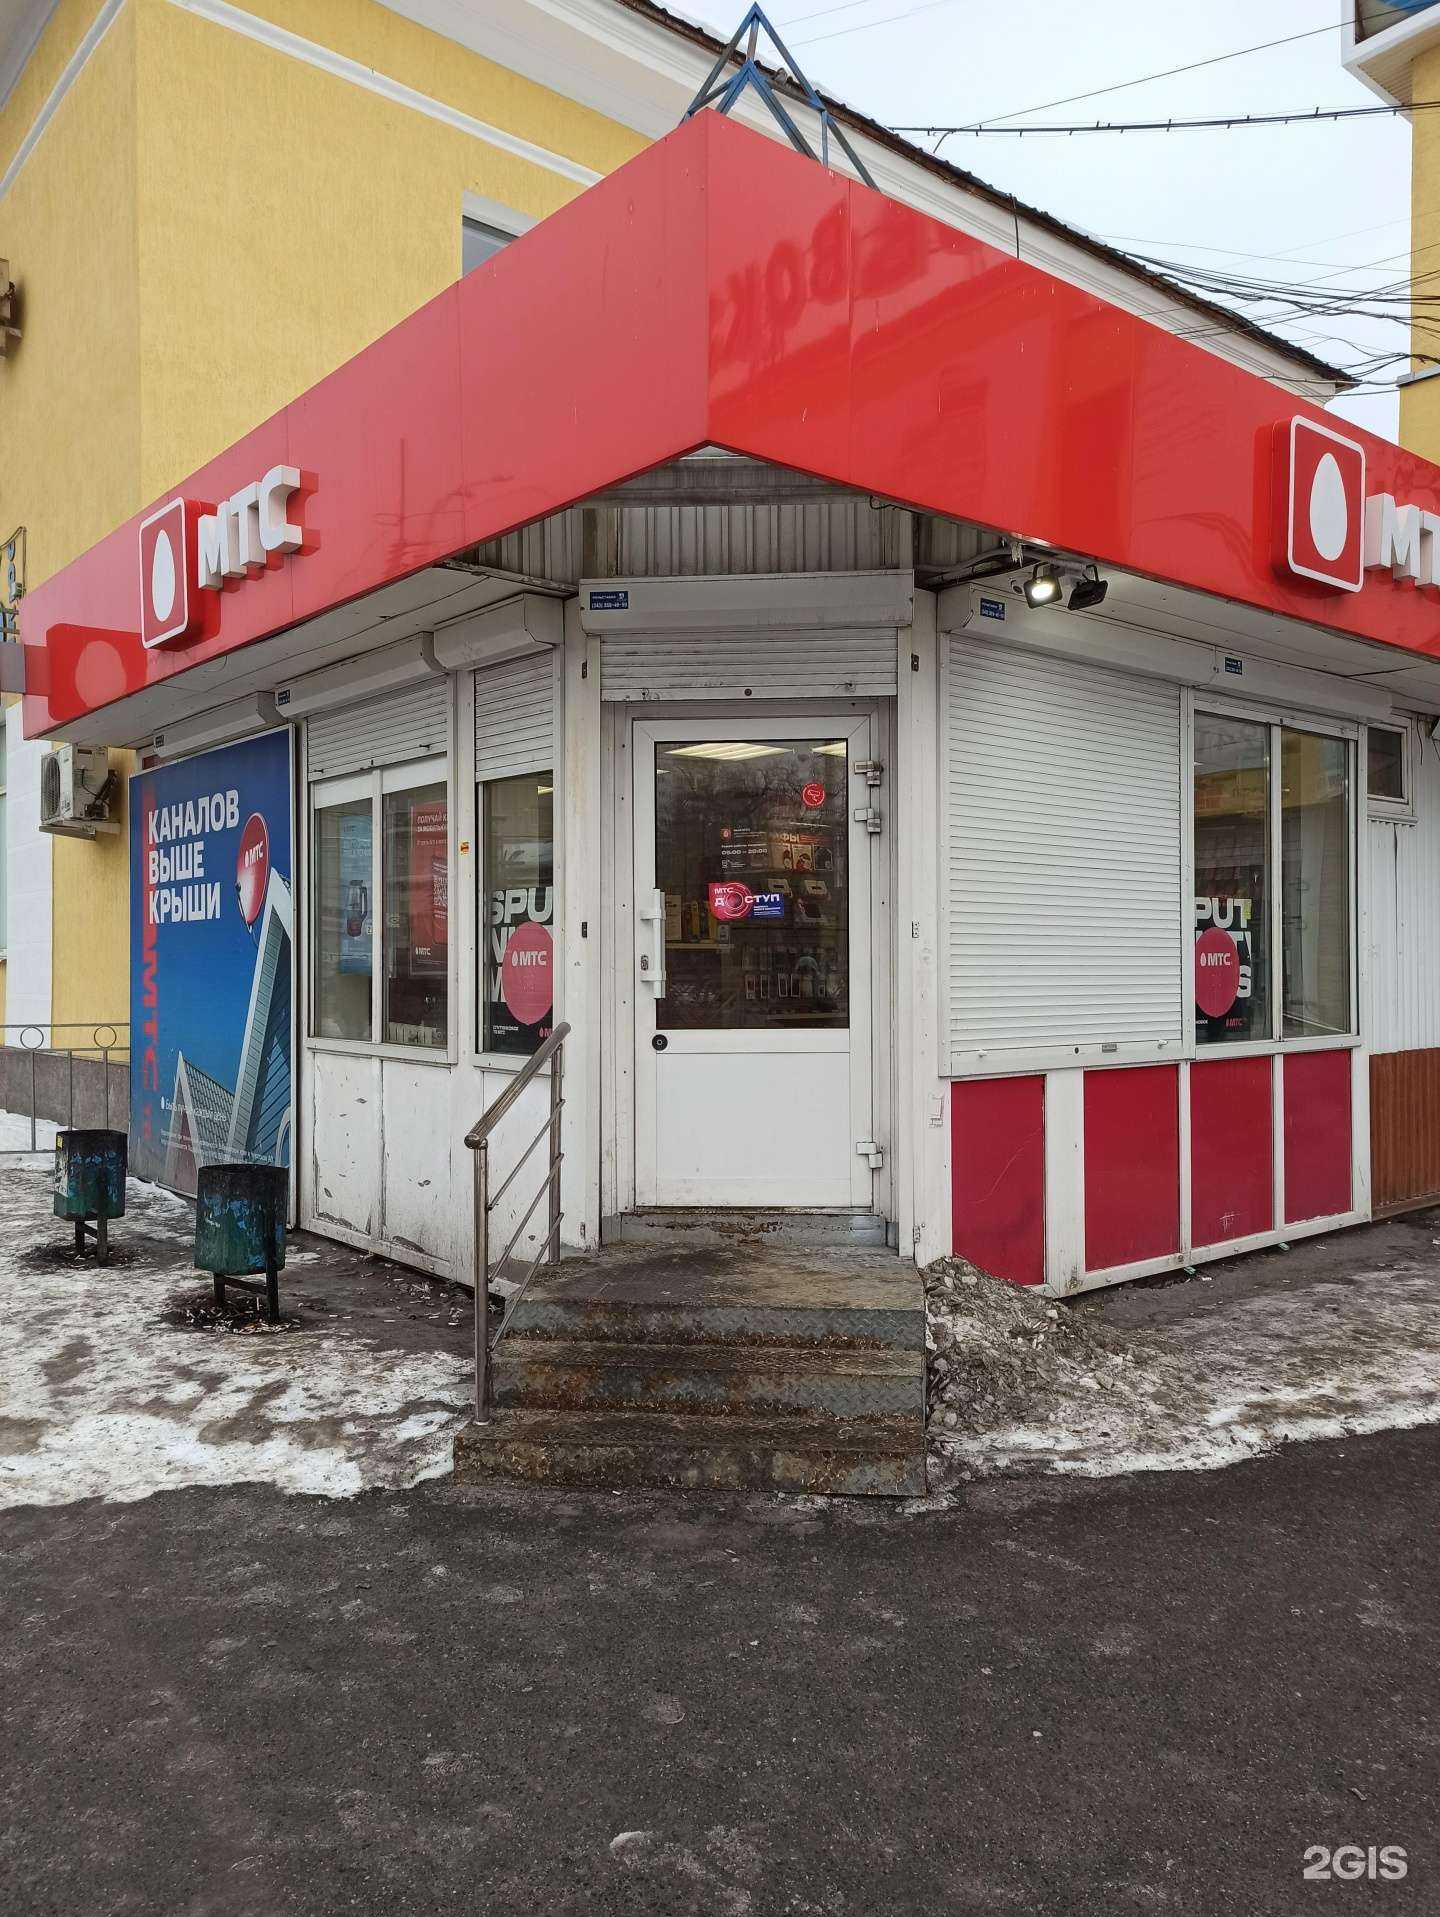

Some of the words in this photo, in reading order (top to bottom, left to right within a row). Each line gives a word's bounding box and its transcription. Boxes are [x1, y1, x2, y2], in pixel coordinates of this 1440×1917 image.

[198, 465, 302, 590] МТС
[148, 789, 240, 845] КАНАЛОВ
[148, 840, 205, 885] ВЫШЕ
[250, 841, 264, 865] МТС
[149, 882, 221, 924] КРЫШИ
[519, 950, 548, 967] МТС
[1208, 952, 1231, 967] МТС
